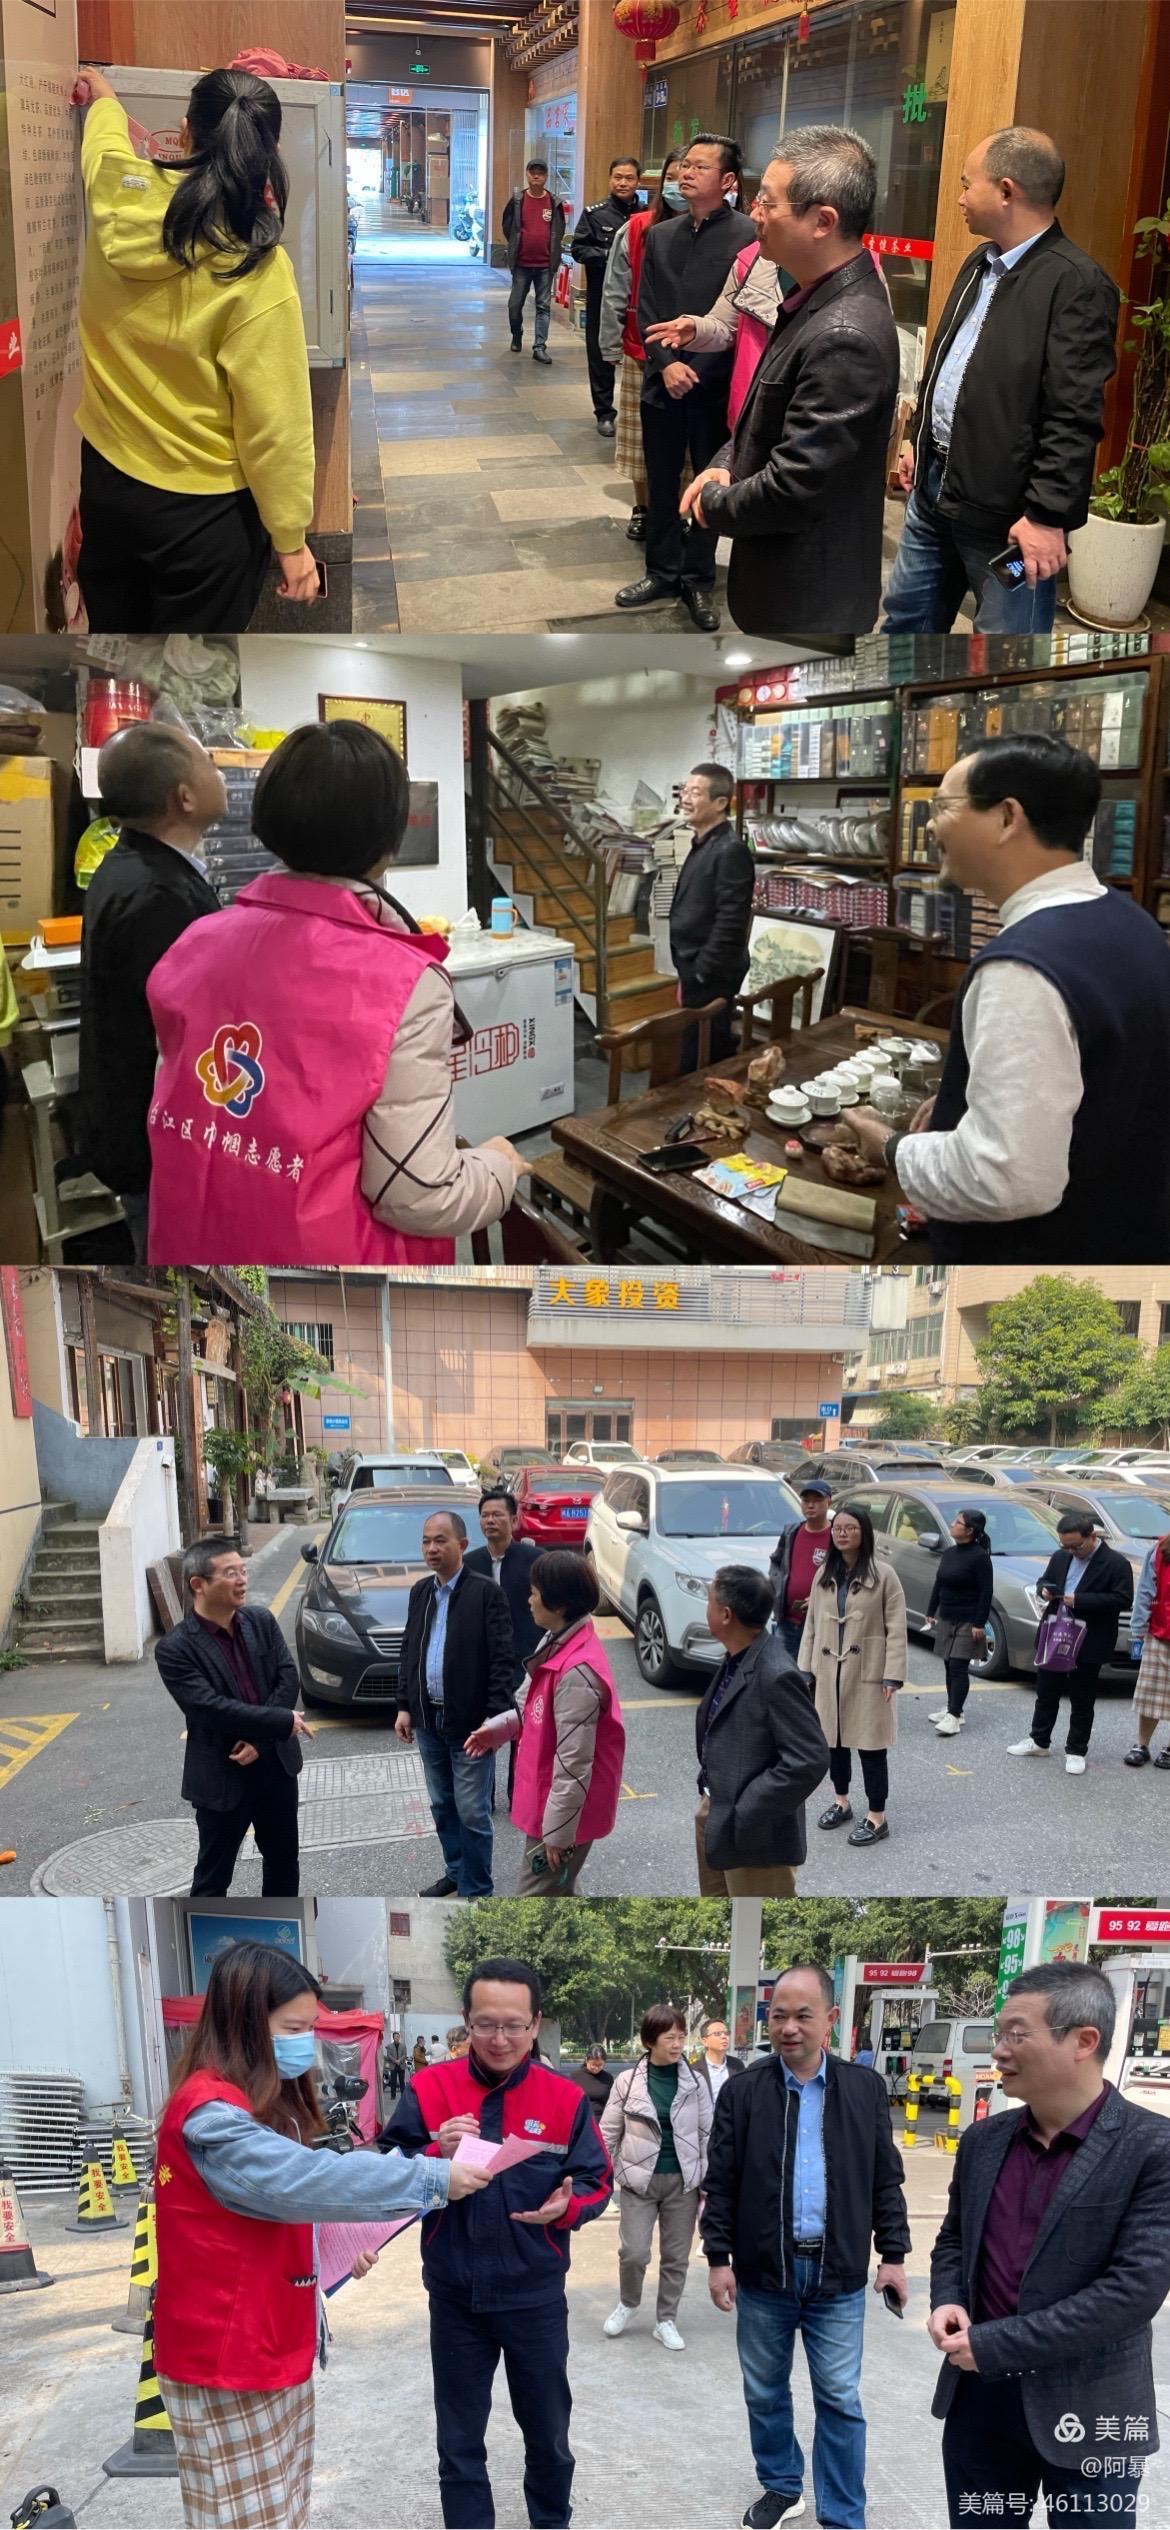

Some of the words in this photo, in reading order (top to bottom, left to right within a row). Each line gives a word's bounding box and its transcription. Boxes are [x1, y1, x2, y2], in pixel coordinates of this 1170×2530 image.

[903, 83, 927, 123] 批
[149, 1102, 304, 1183] 台江区巾帼志愿者
[548, 1276, 679, 1310] 大象投资
[1006, 1928, 1021, 1949] 98
[1108, 1920, 1123, 1931] 95
[1127, 1920, 1141, 1931] 92
[869, 1969, 878, 1977] 95
[1003, 1954, 1019, 1975] 95
[117, 2144, 131, 2180] 我要安全
[91, 2168, 108, 2212] 我要安全
[2, 2200, 16, 2243] 我要安全
